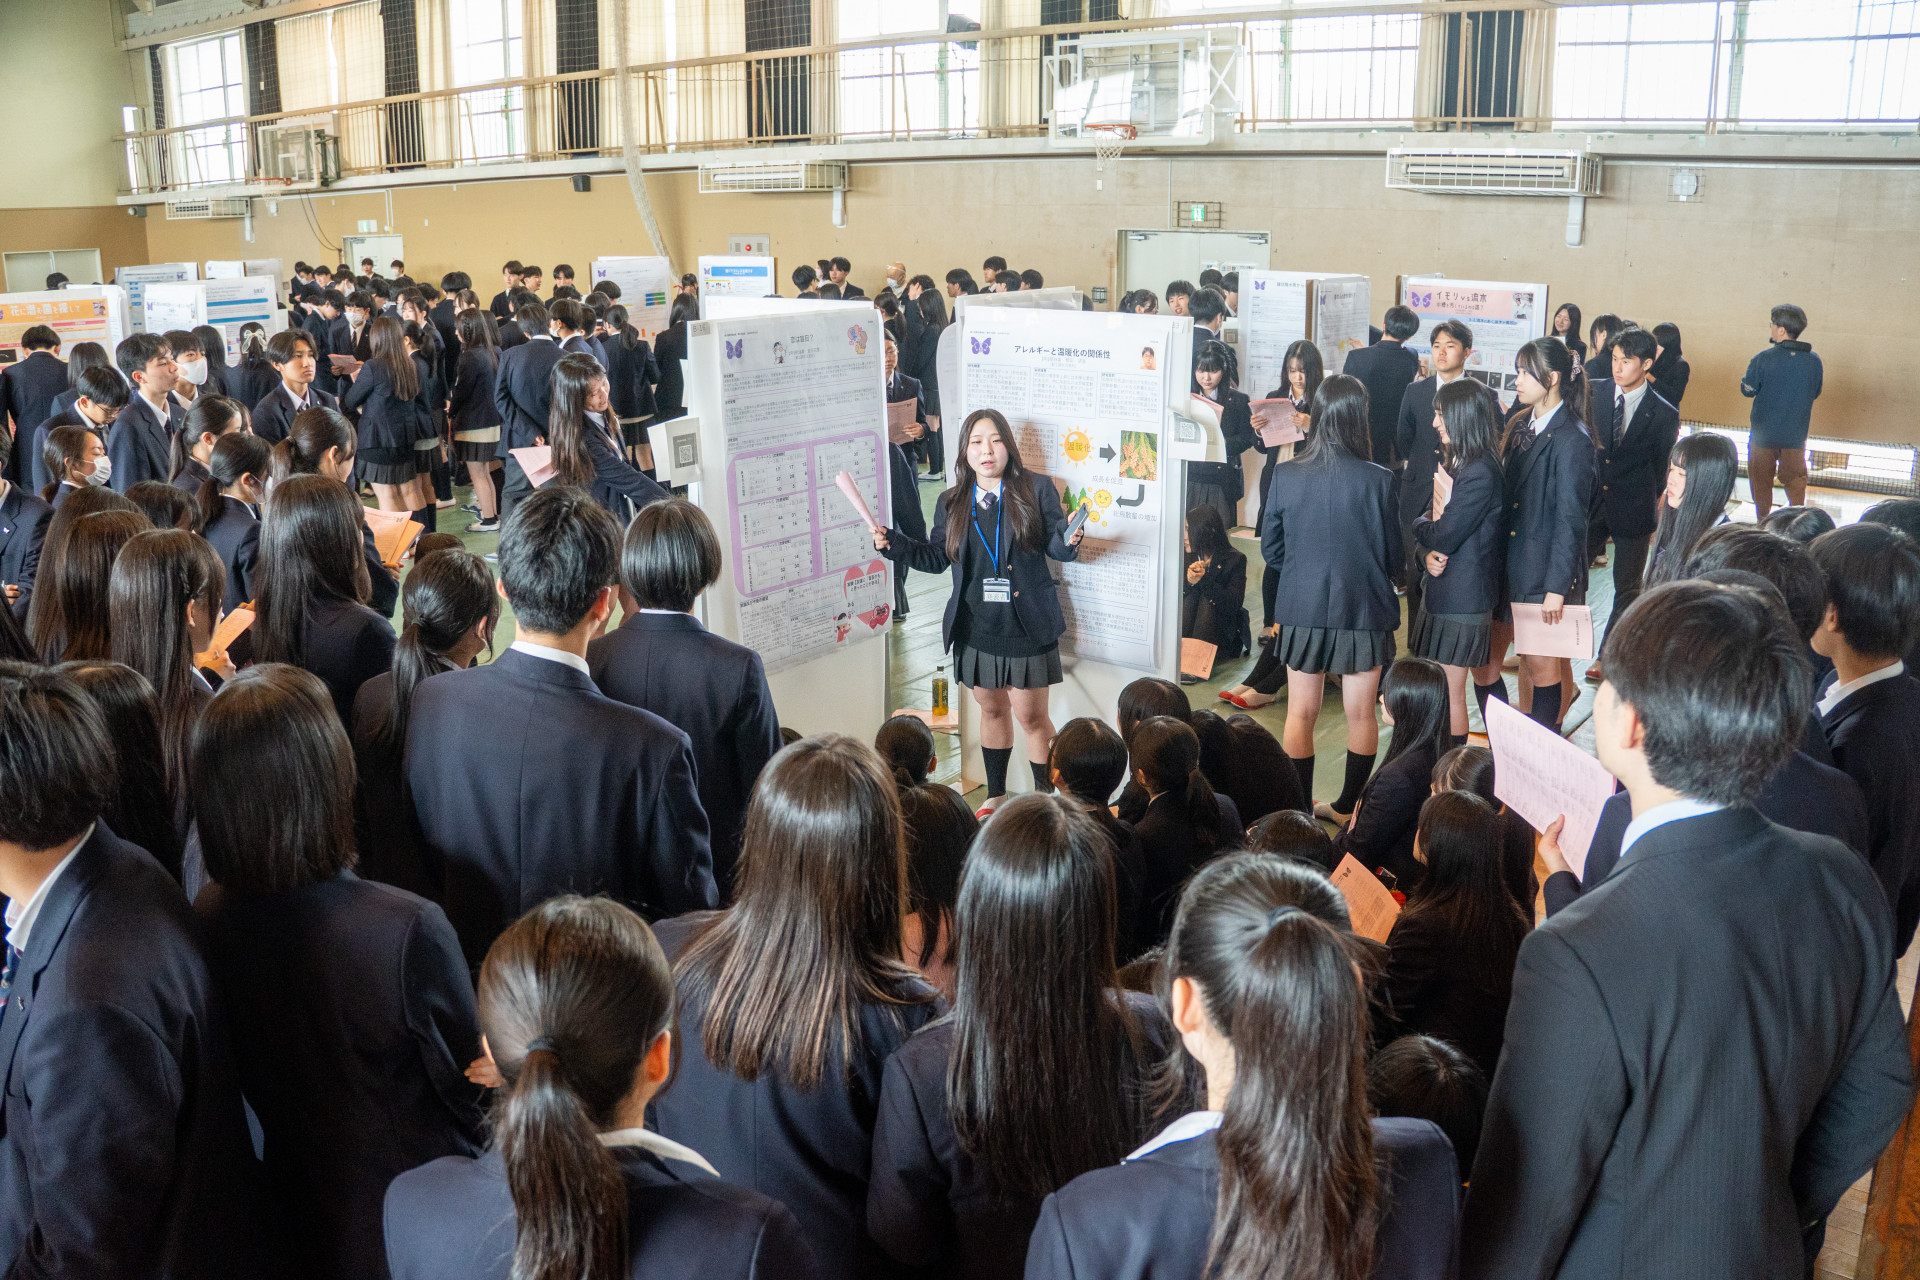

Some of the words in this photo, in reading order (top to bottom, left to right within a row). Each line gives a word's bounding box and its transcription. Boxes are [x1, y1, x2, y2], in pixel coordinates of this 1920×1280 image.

[10, 302, 81, 317] 花に潜む菌を探して
[1014, 345, 1111, 360] アレルギーと温暖化の関係性
[1066, 441, 1092, 453] 温暖化
